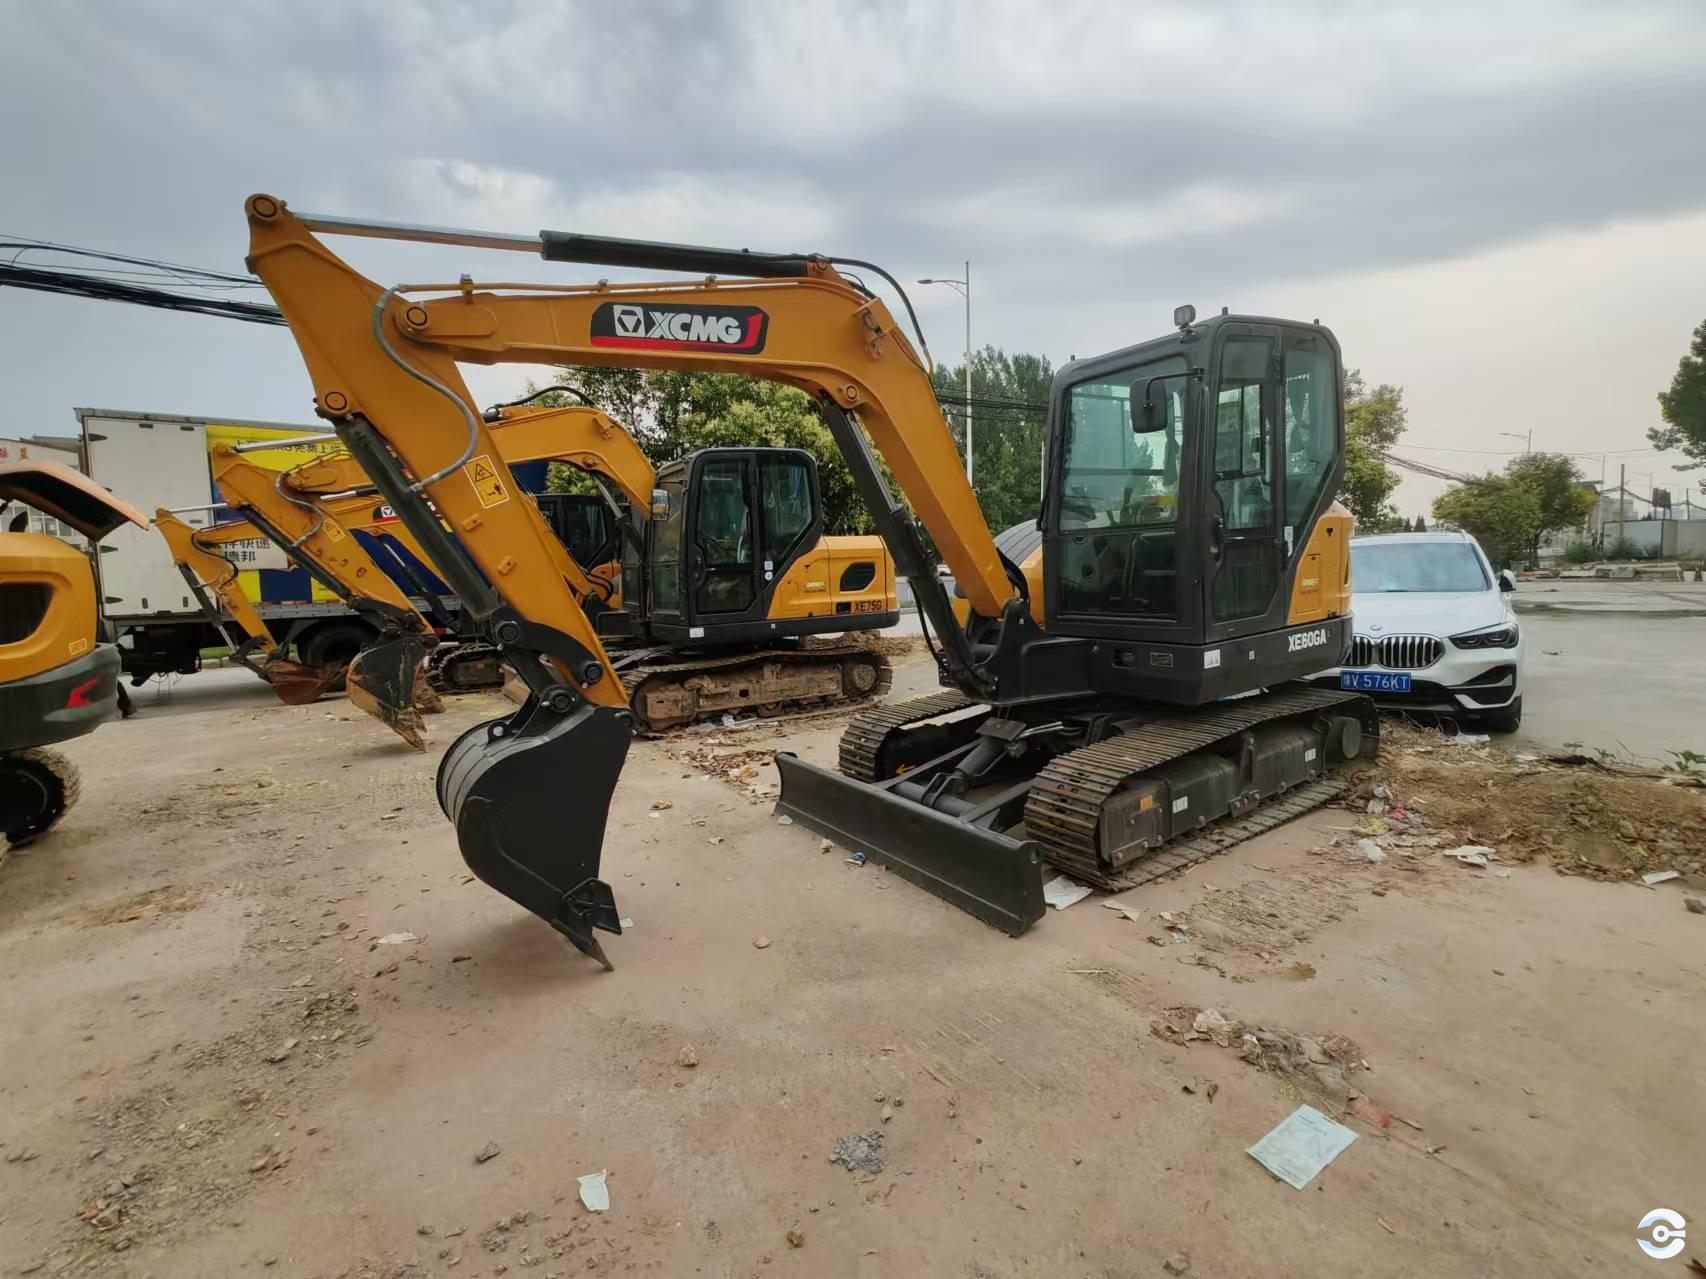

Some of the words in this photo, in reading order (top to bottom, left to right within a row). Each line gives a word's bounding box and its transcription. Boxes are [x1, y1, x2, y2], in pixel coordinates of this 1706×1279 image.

[647, 311, 742, 344] XCMG
[854, 600, 883, 613] XE75G
[1287, 629, 1328, 652] XE60GA
